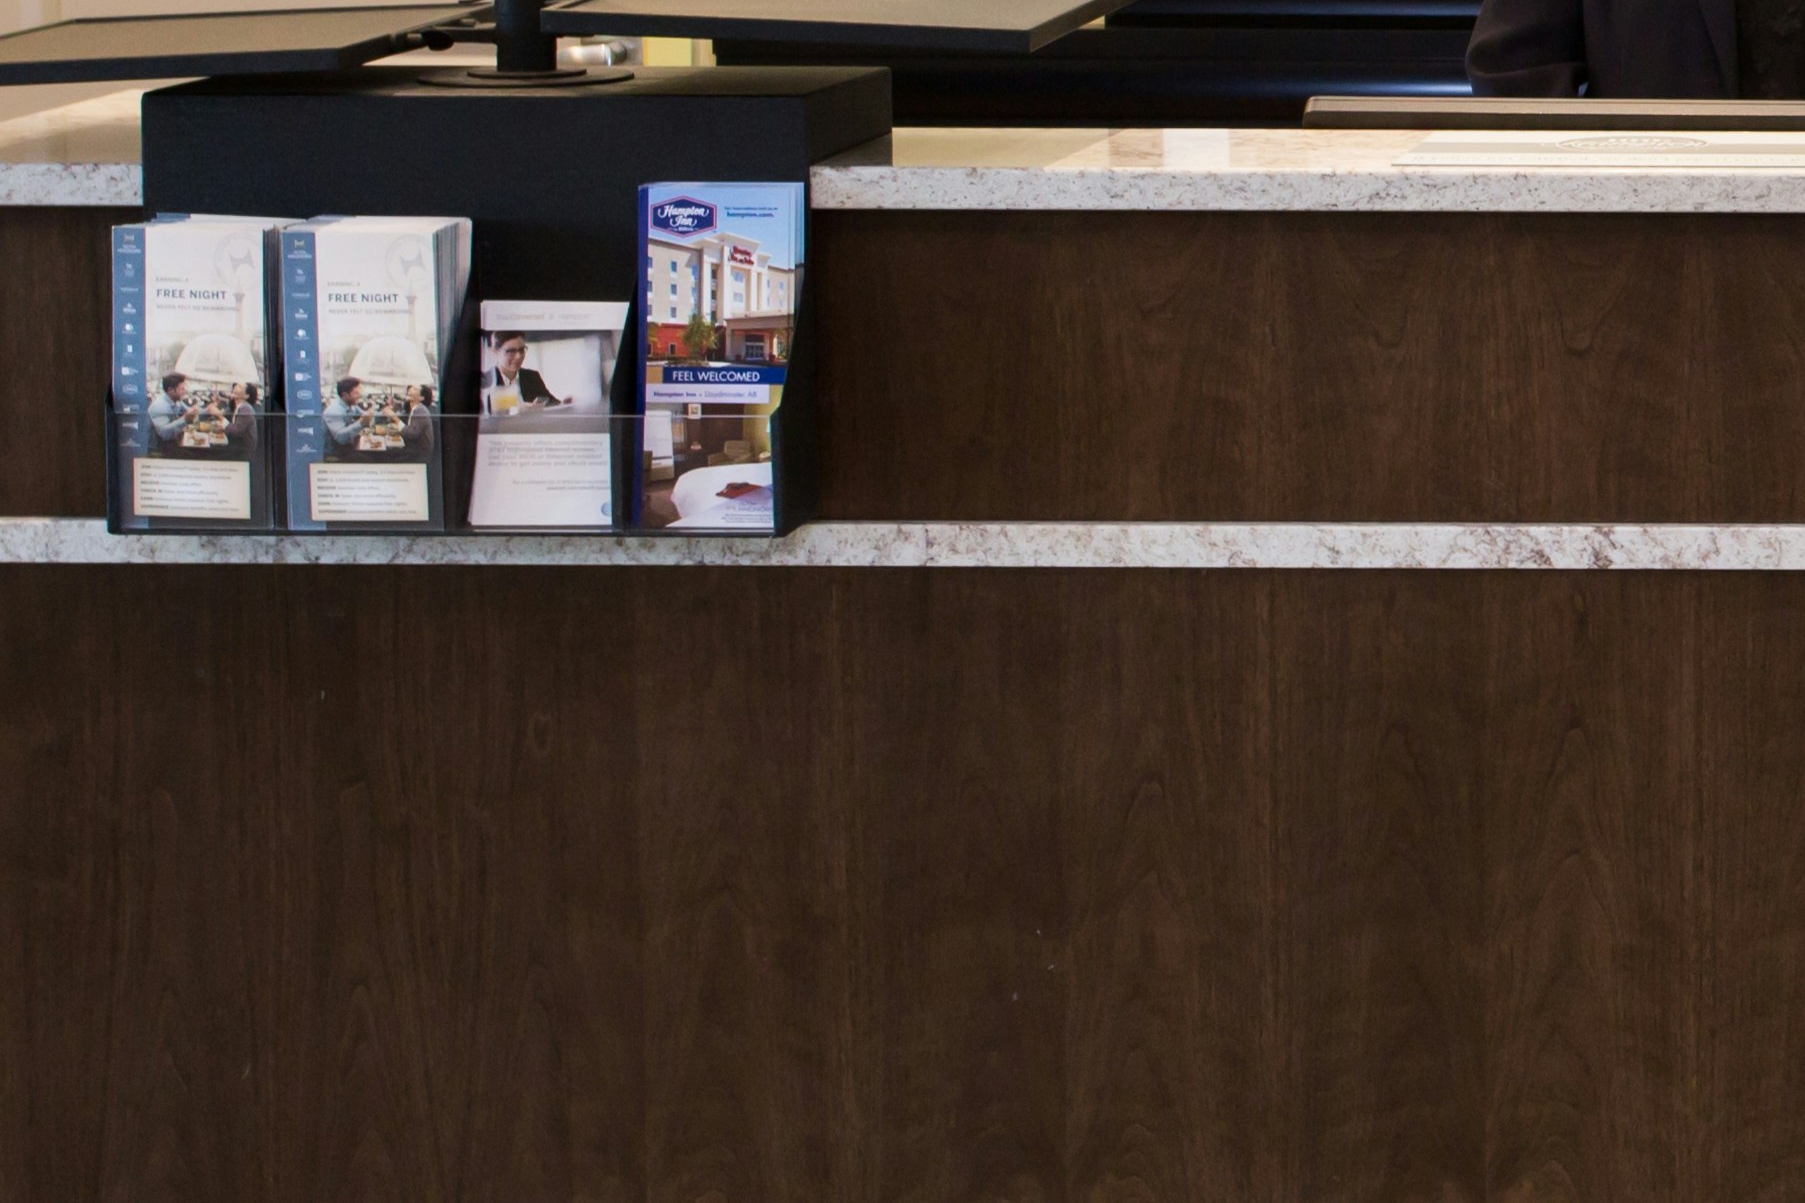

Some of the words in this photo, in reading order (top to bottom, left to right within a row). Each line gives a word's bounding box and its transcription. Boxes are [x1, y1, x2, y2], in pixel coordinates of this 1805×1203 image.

[657, 204, 710, 219] Hampton
[156, 288, 186, 299] FREE
[189, 290, 227, 300] NIGHT
[328, 293, 358, 303] FREE
[361, 293, 399, 303] NIGHT
[672, 371, 694, 381] FEEL
[697, 371, 760, 383] WELCOMED
